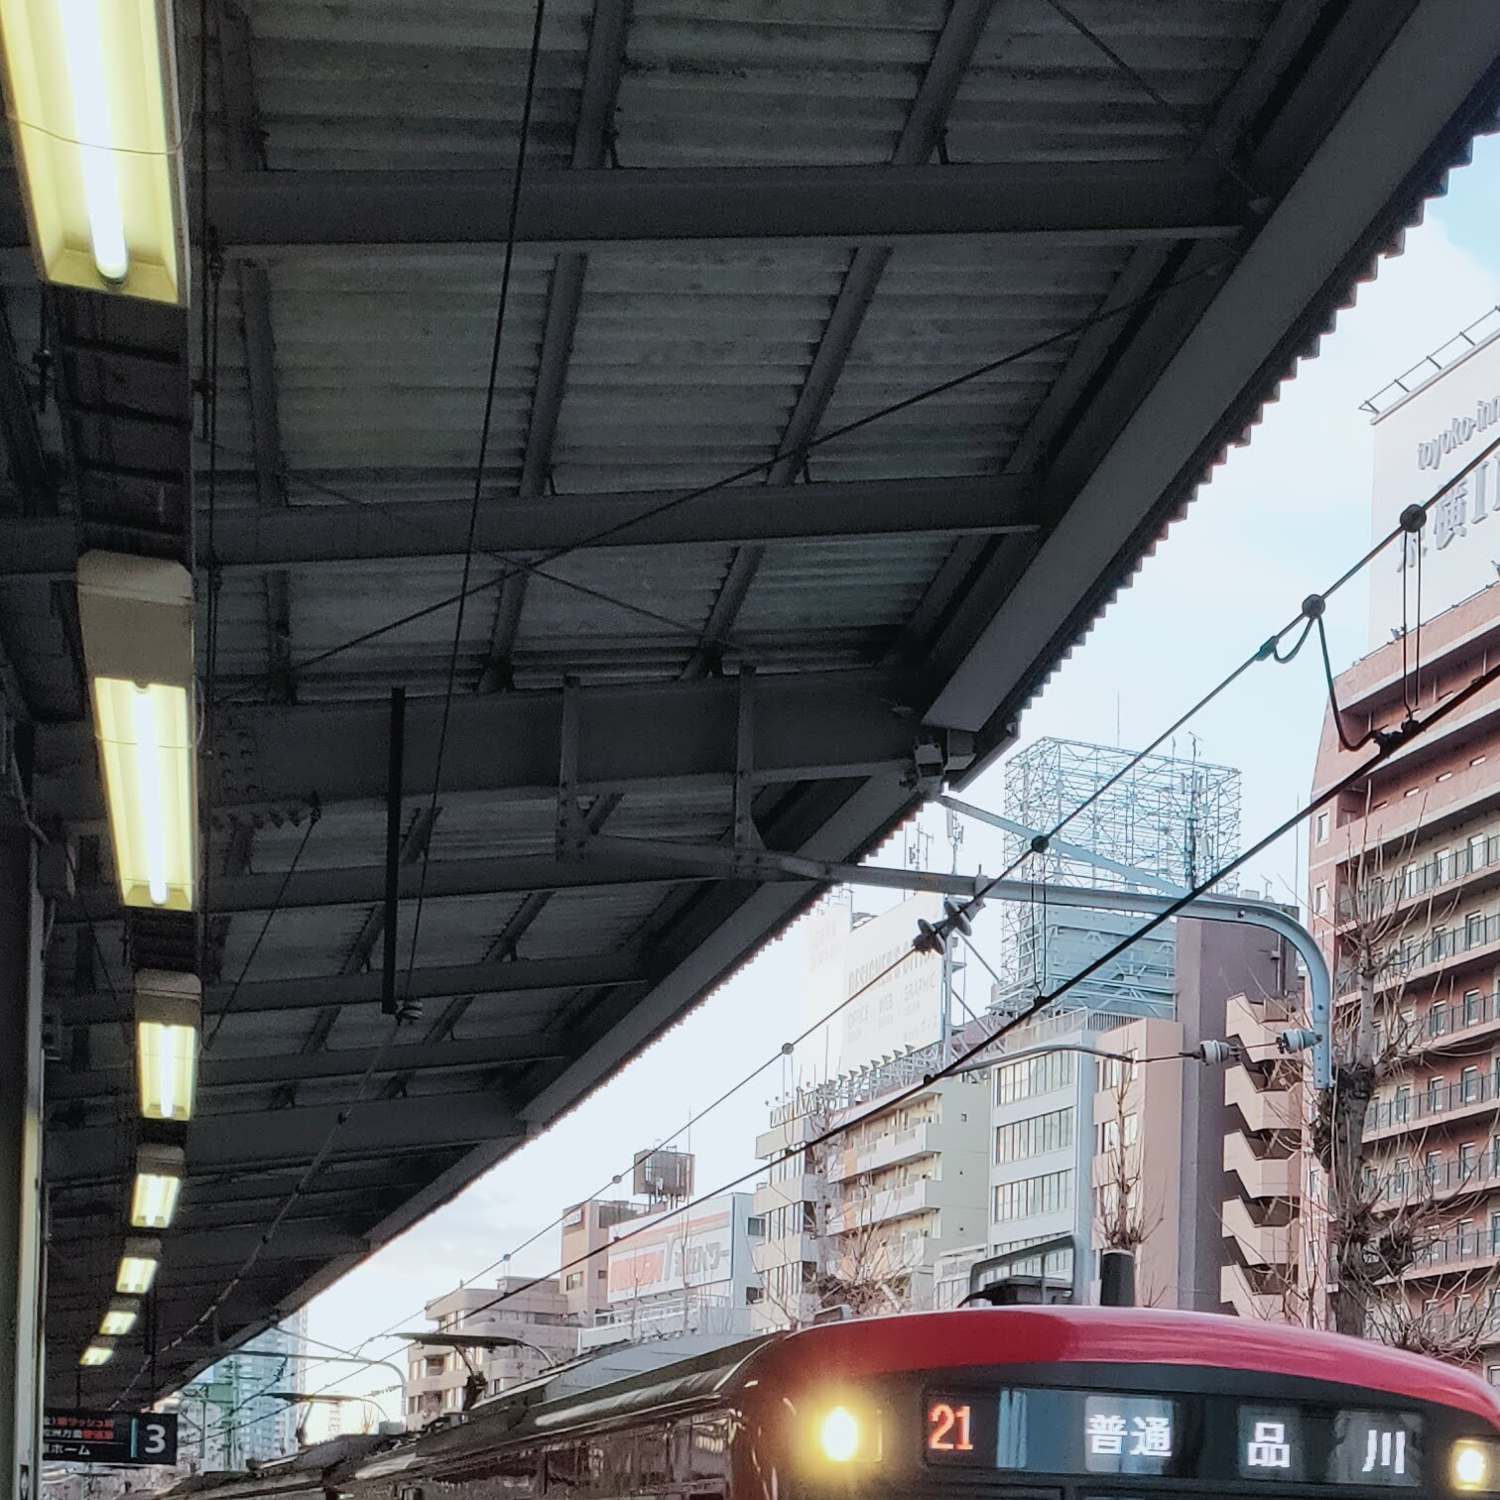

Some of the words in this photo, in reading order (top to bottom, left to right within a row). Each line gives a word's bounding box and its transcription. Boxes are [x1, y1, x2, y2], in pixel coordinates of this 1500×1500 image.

[144, 1424, 166, 1453] 3
[928, 1403, 974, 1451] 21
[1087, 1416, 1173, 1458] 普通
